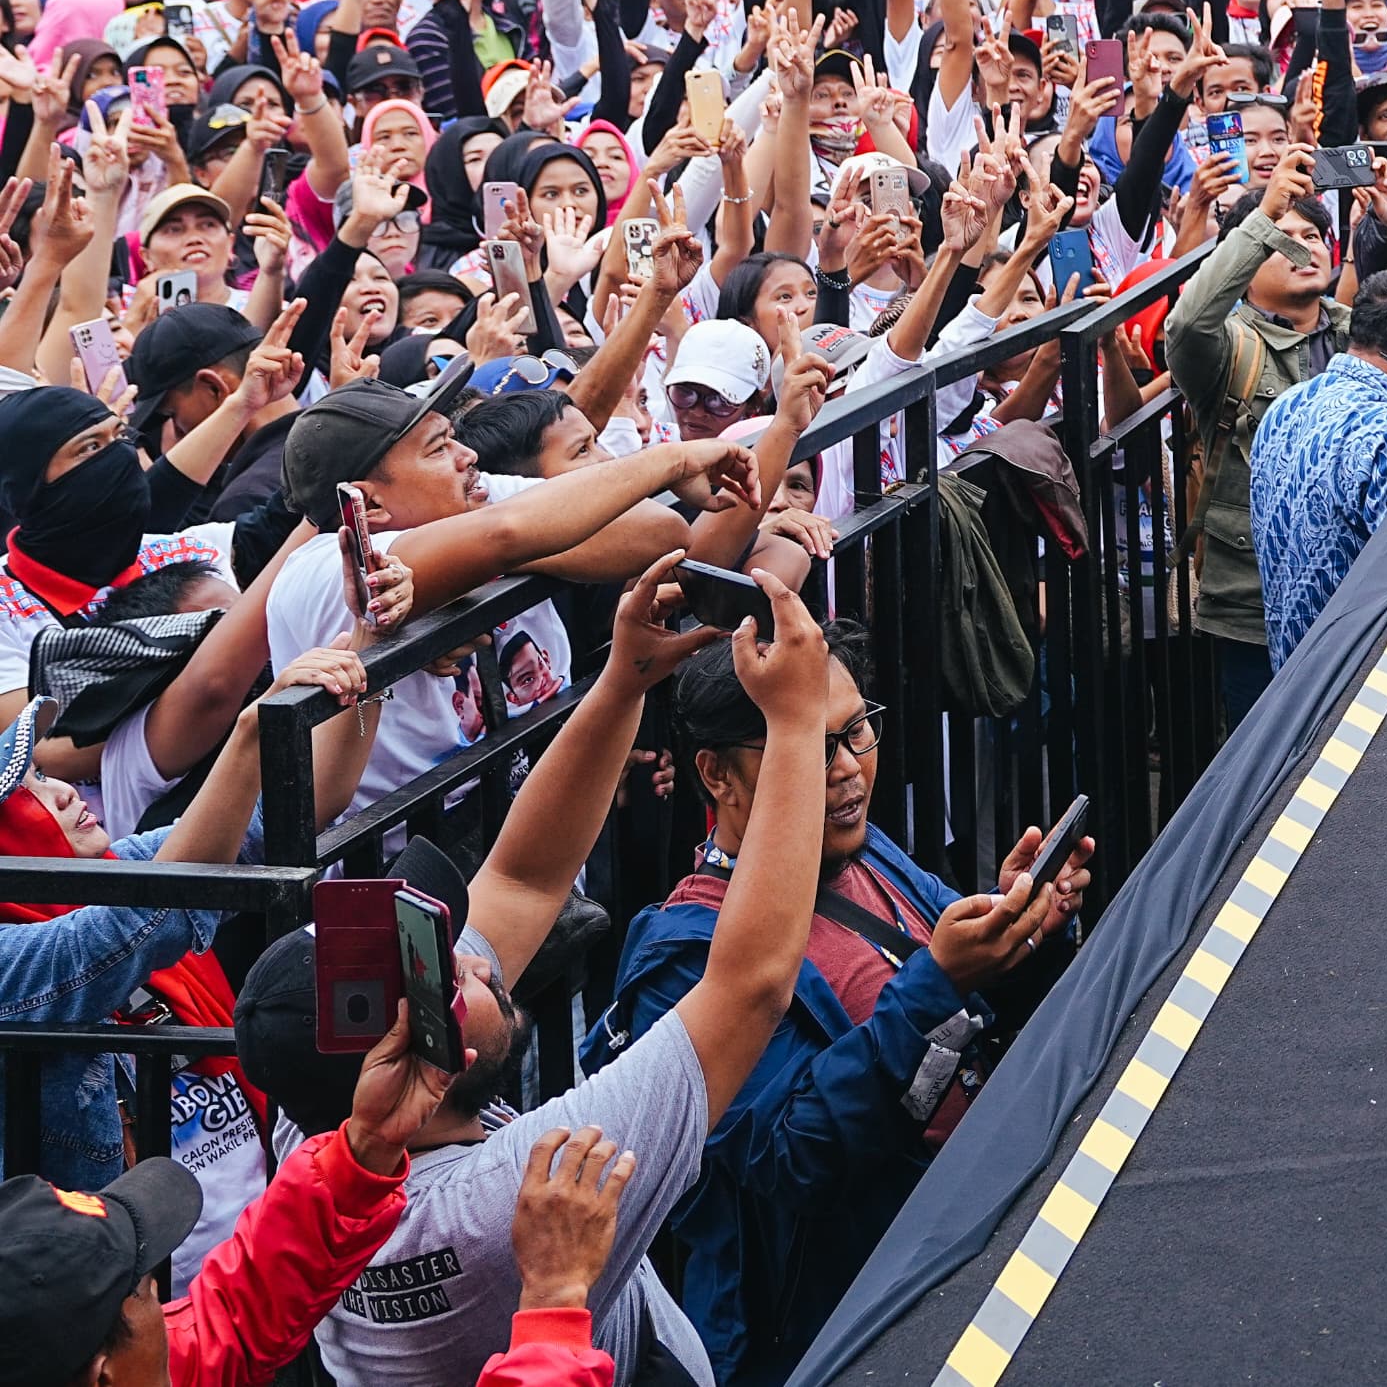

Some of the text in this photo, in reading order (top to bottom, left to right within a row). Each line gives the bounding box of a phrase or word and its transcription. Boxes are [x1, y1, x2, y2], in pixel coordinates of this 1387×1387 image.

[181, 1135, 220, 1164] CALON
[222, 1116, 256, 1142] PRESID
[206, 1140, 242, 1164] WAKIL
[370, 1289, 448, 1319] VISION
